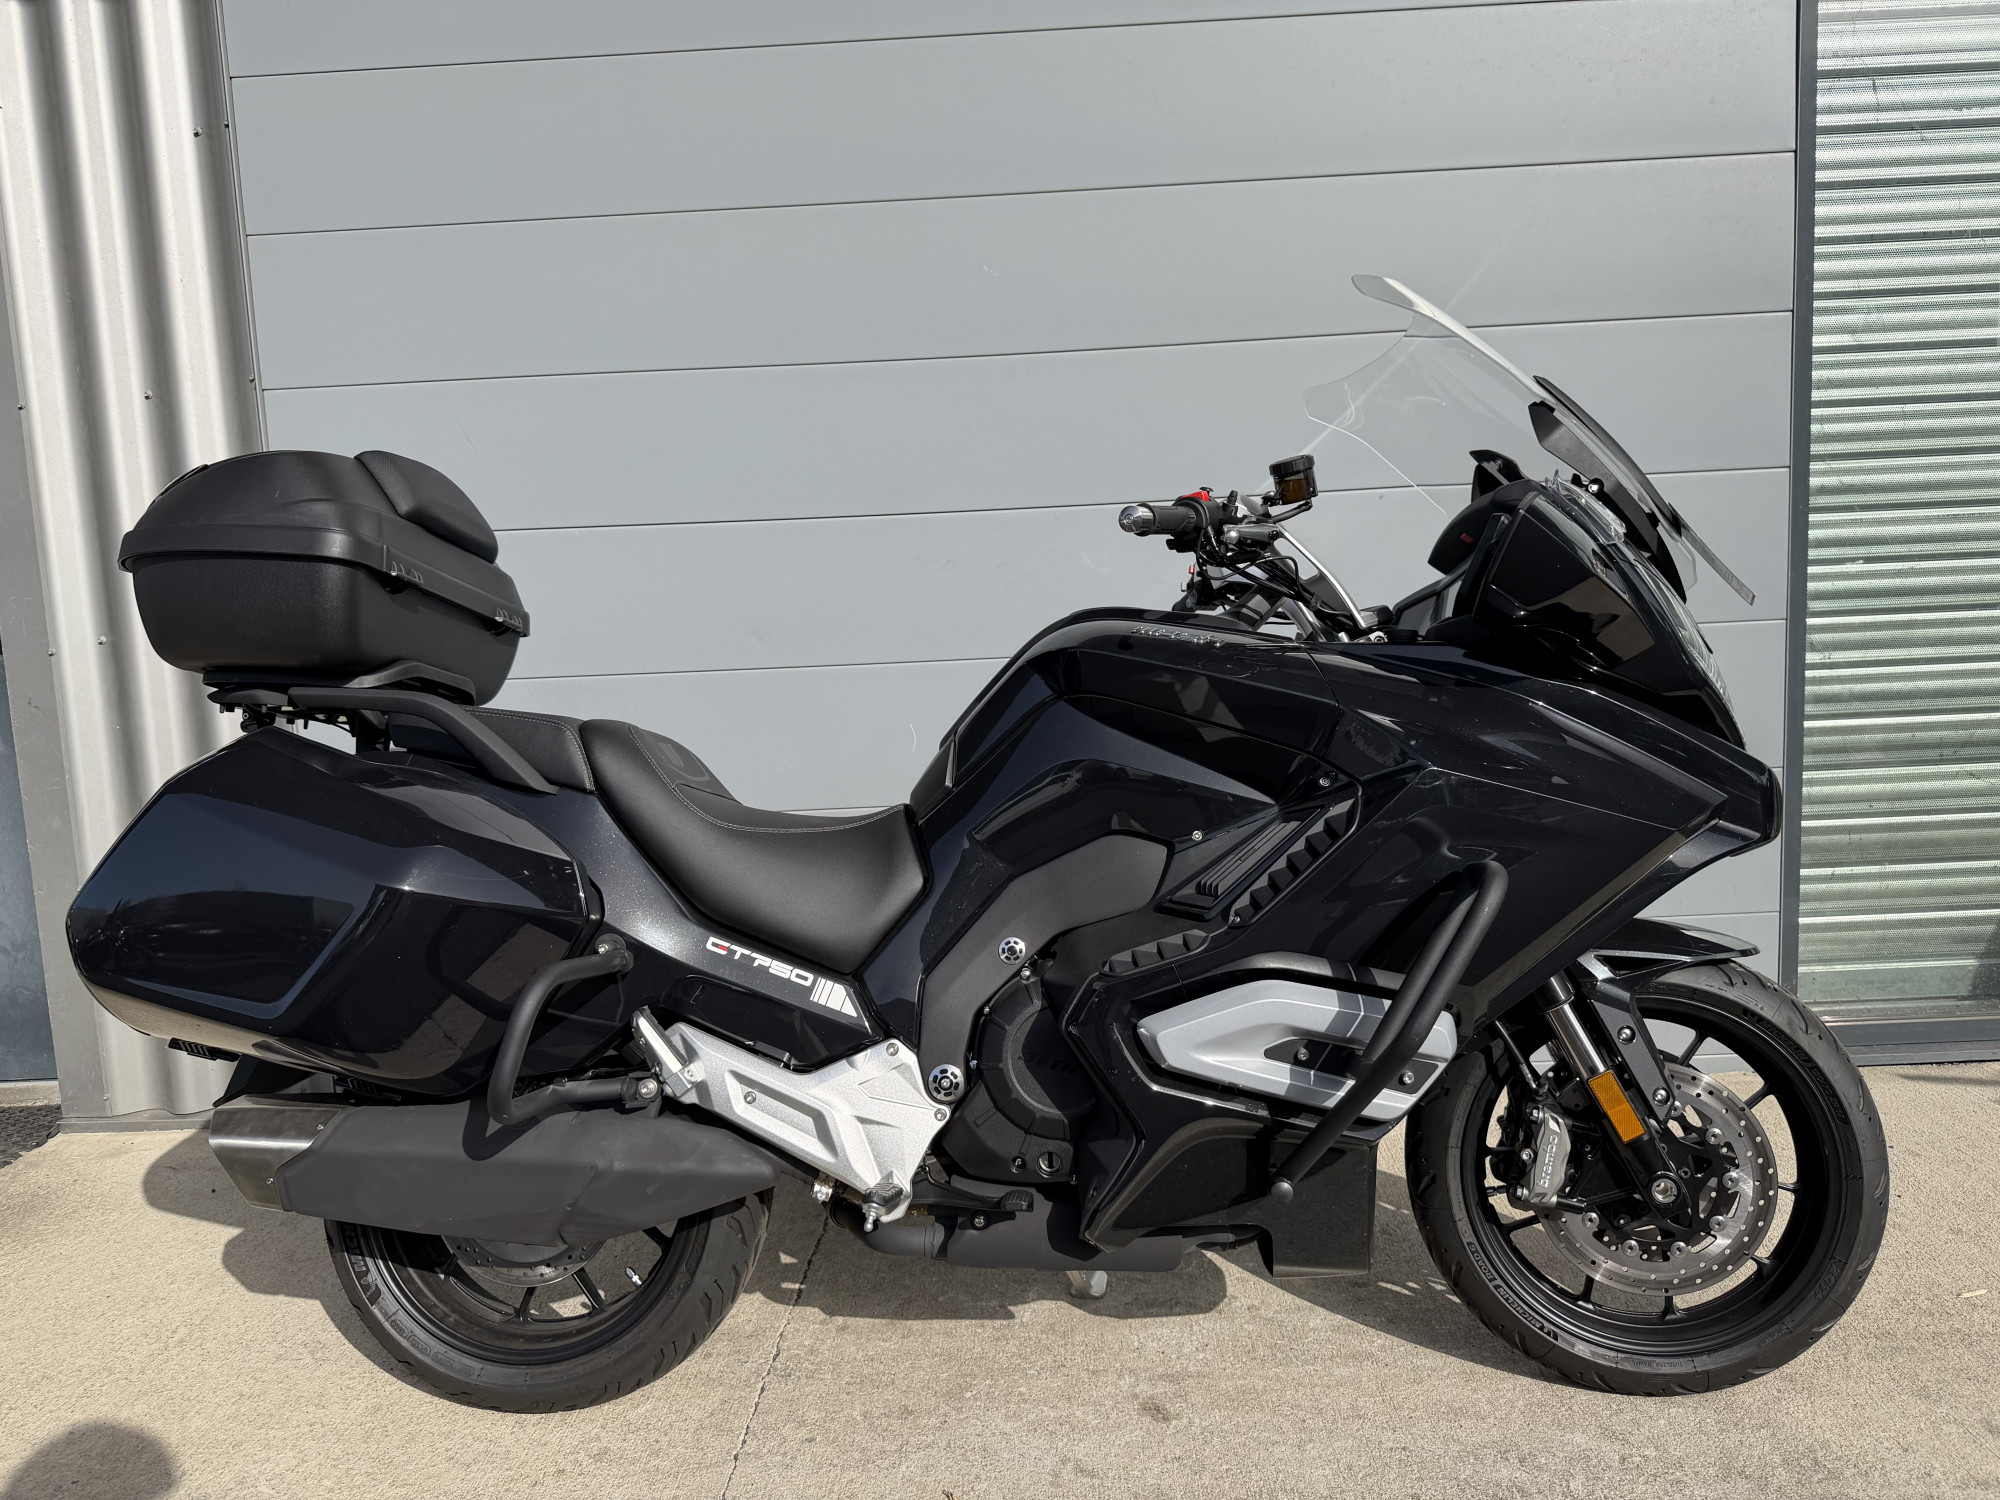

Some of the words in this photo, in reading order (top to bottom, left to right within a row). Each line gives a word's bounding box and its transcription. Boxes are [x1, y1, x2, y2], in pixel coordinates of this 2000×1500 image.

[706, 936, 815, 986] GT750
[1537, 1135, 1558, 1187] brembo
[1473, 1252, 1494, 1280] ROAD
[1497, 1286, 1542, 1328] MICHELIN
